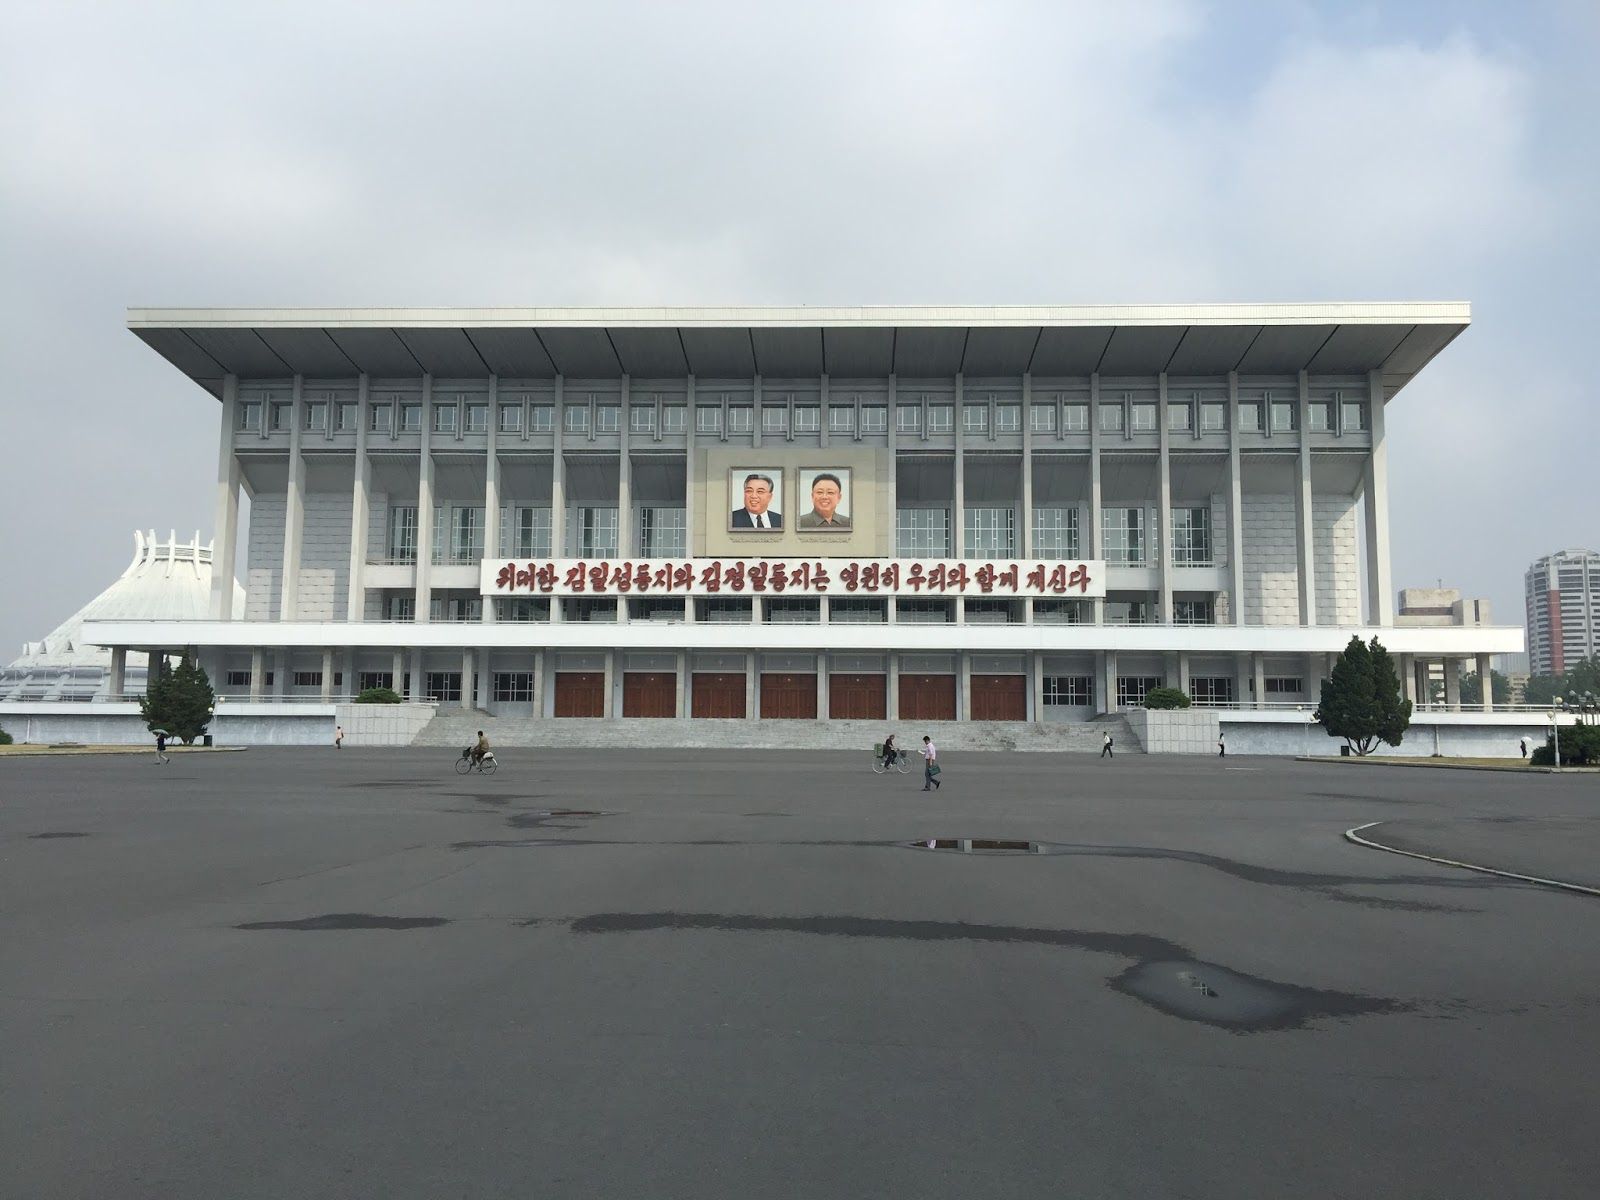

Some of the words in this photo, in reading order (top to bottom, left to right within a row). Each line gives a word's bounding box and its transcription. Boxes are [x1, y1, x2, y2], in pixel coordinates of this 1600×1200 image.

[496, 562, 559, 592] 위대한
[563, 561, 696, 593] 김일성동지와
[699, 561, 830, 592] 김정일동지는
[839, 562, 900, 592] 영원히
[906, 562, 970, 592] 우리와
[974, 563, 1018, 593] 함께
[1026, 564, 1092, 593] 계신다
